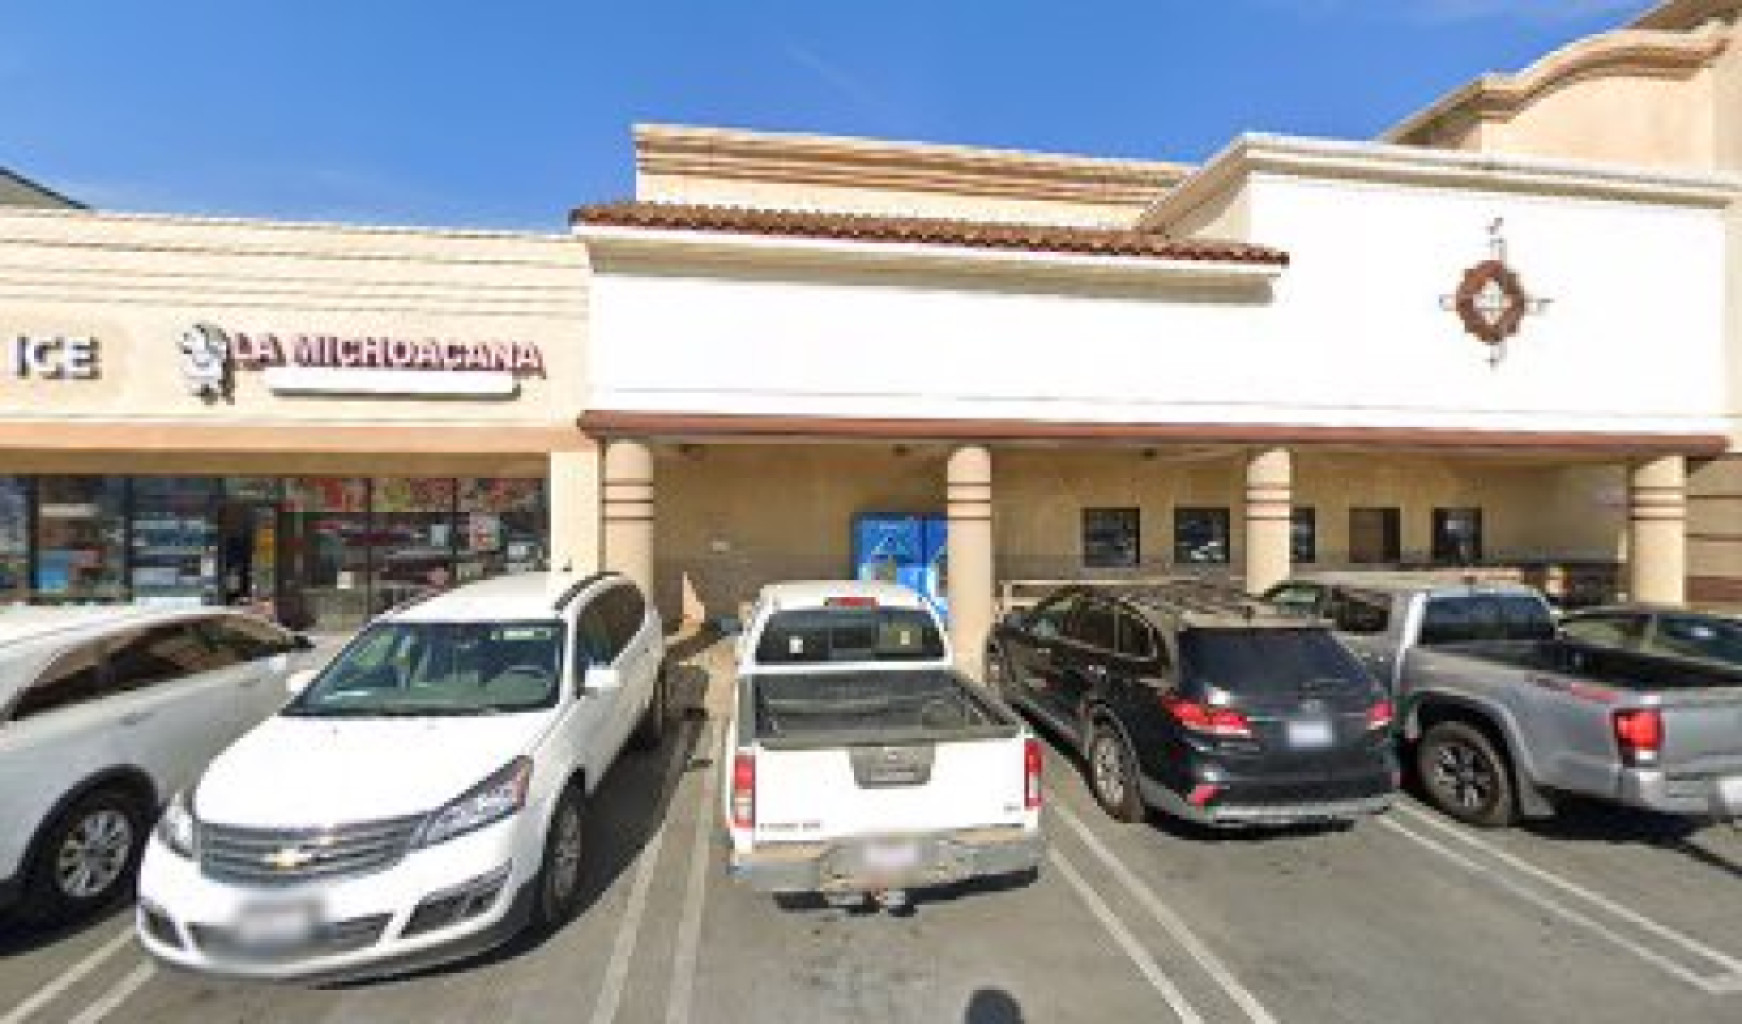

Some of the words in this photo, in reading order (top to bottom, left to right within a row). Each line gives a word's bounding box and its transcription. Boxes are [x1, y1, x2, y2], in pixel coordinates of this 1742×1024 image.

[8, 336, 100, 380] ICE
[233, 333, 283, 368] LA
[293, 336, 544, 375] MICHOACANA
